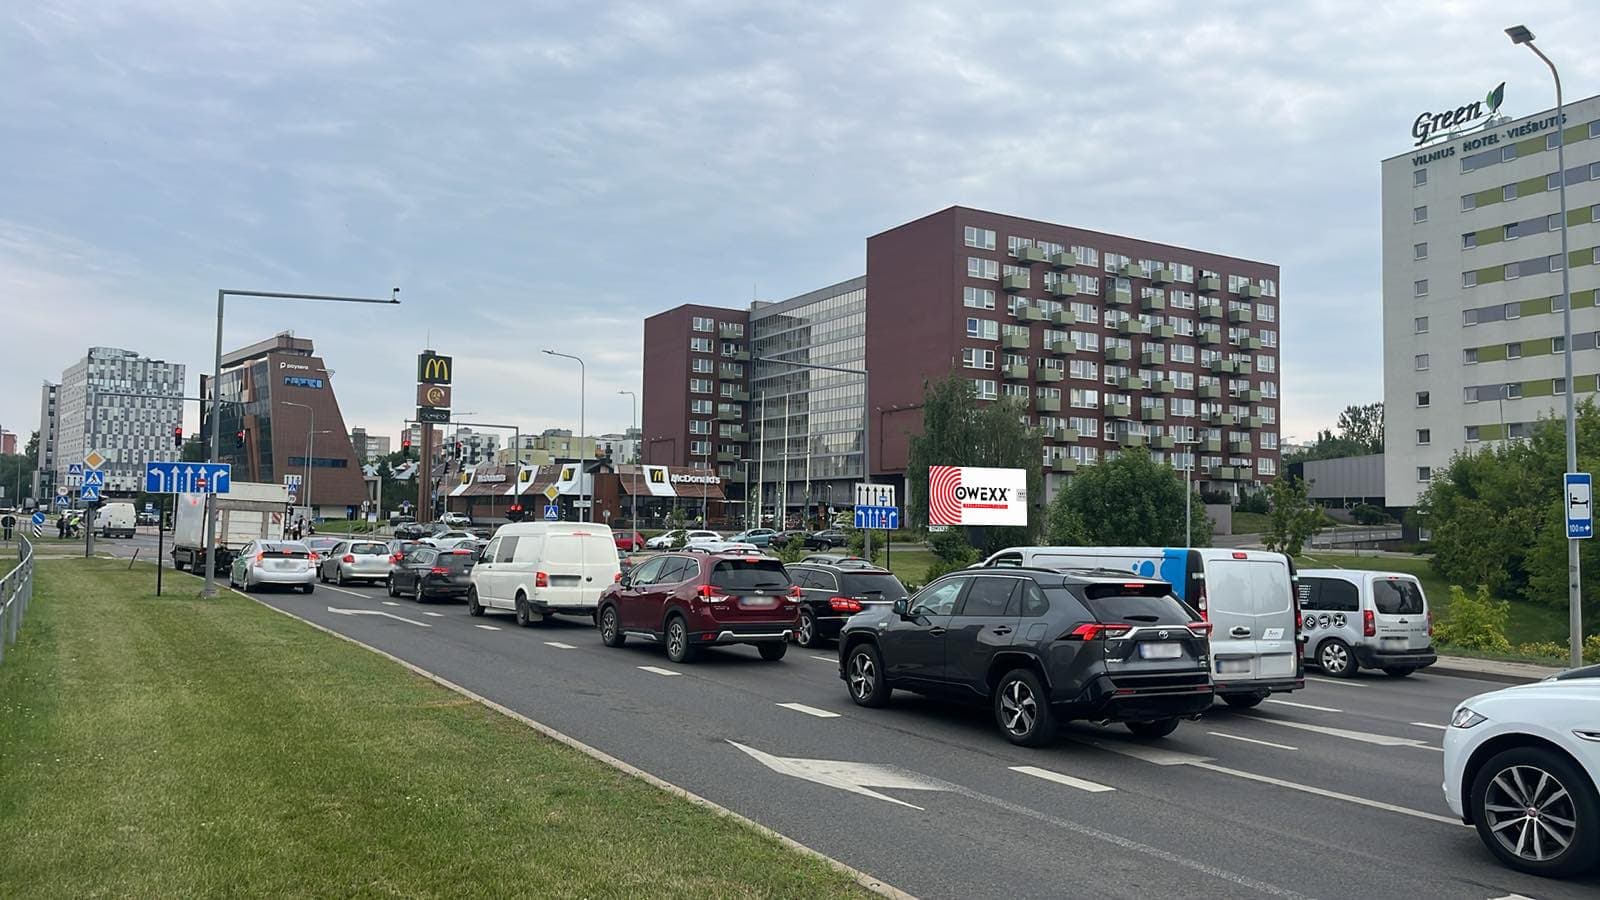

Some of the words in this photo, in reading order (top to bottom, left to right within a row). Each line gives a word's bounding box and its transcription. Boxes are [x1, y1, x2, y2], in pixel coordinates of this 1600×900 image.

[1412, 100, 1483, 146] Green
[1412, 147, 1455, 167] VILNIUS
[1463, 133, 1500, 153] HOTEL
[671, 474, 721, 484] McDonald's
[955, 486, 1008, 501] OWEXX
[1569, 524, 1579, 533] 100
